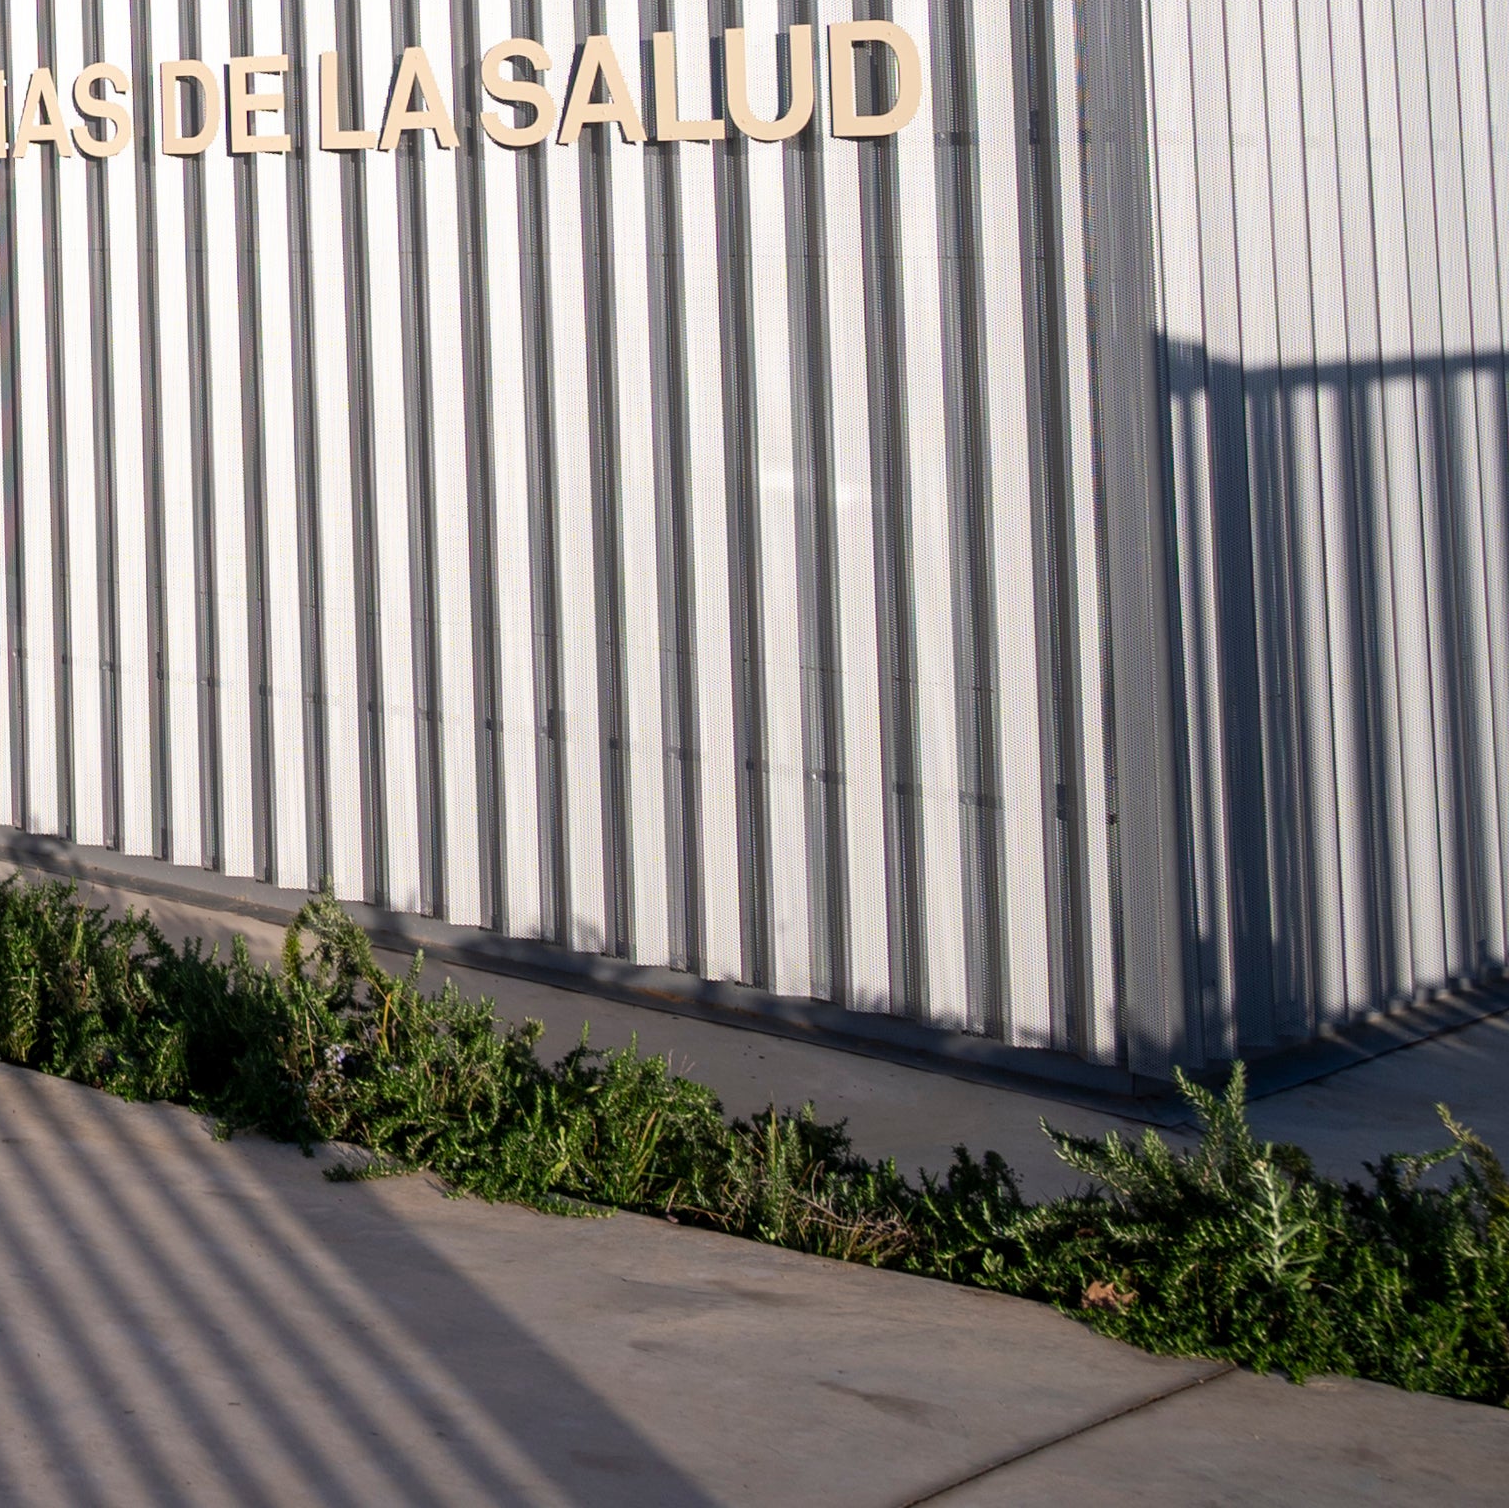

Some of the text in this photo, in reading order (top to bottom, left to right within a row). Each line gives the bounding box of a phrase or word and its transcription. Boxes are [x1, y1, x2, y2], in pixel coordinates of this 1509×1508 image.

[160, 54, 292, 156] DE
[319, 46, 461, 152] LA
[479, 19, 922, 147] SALUD
